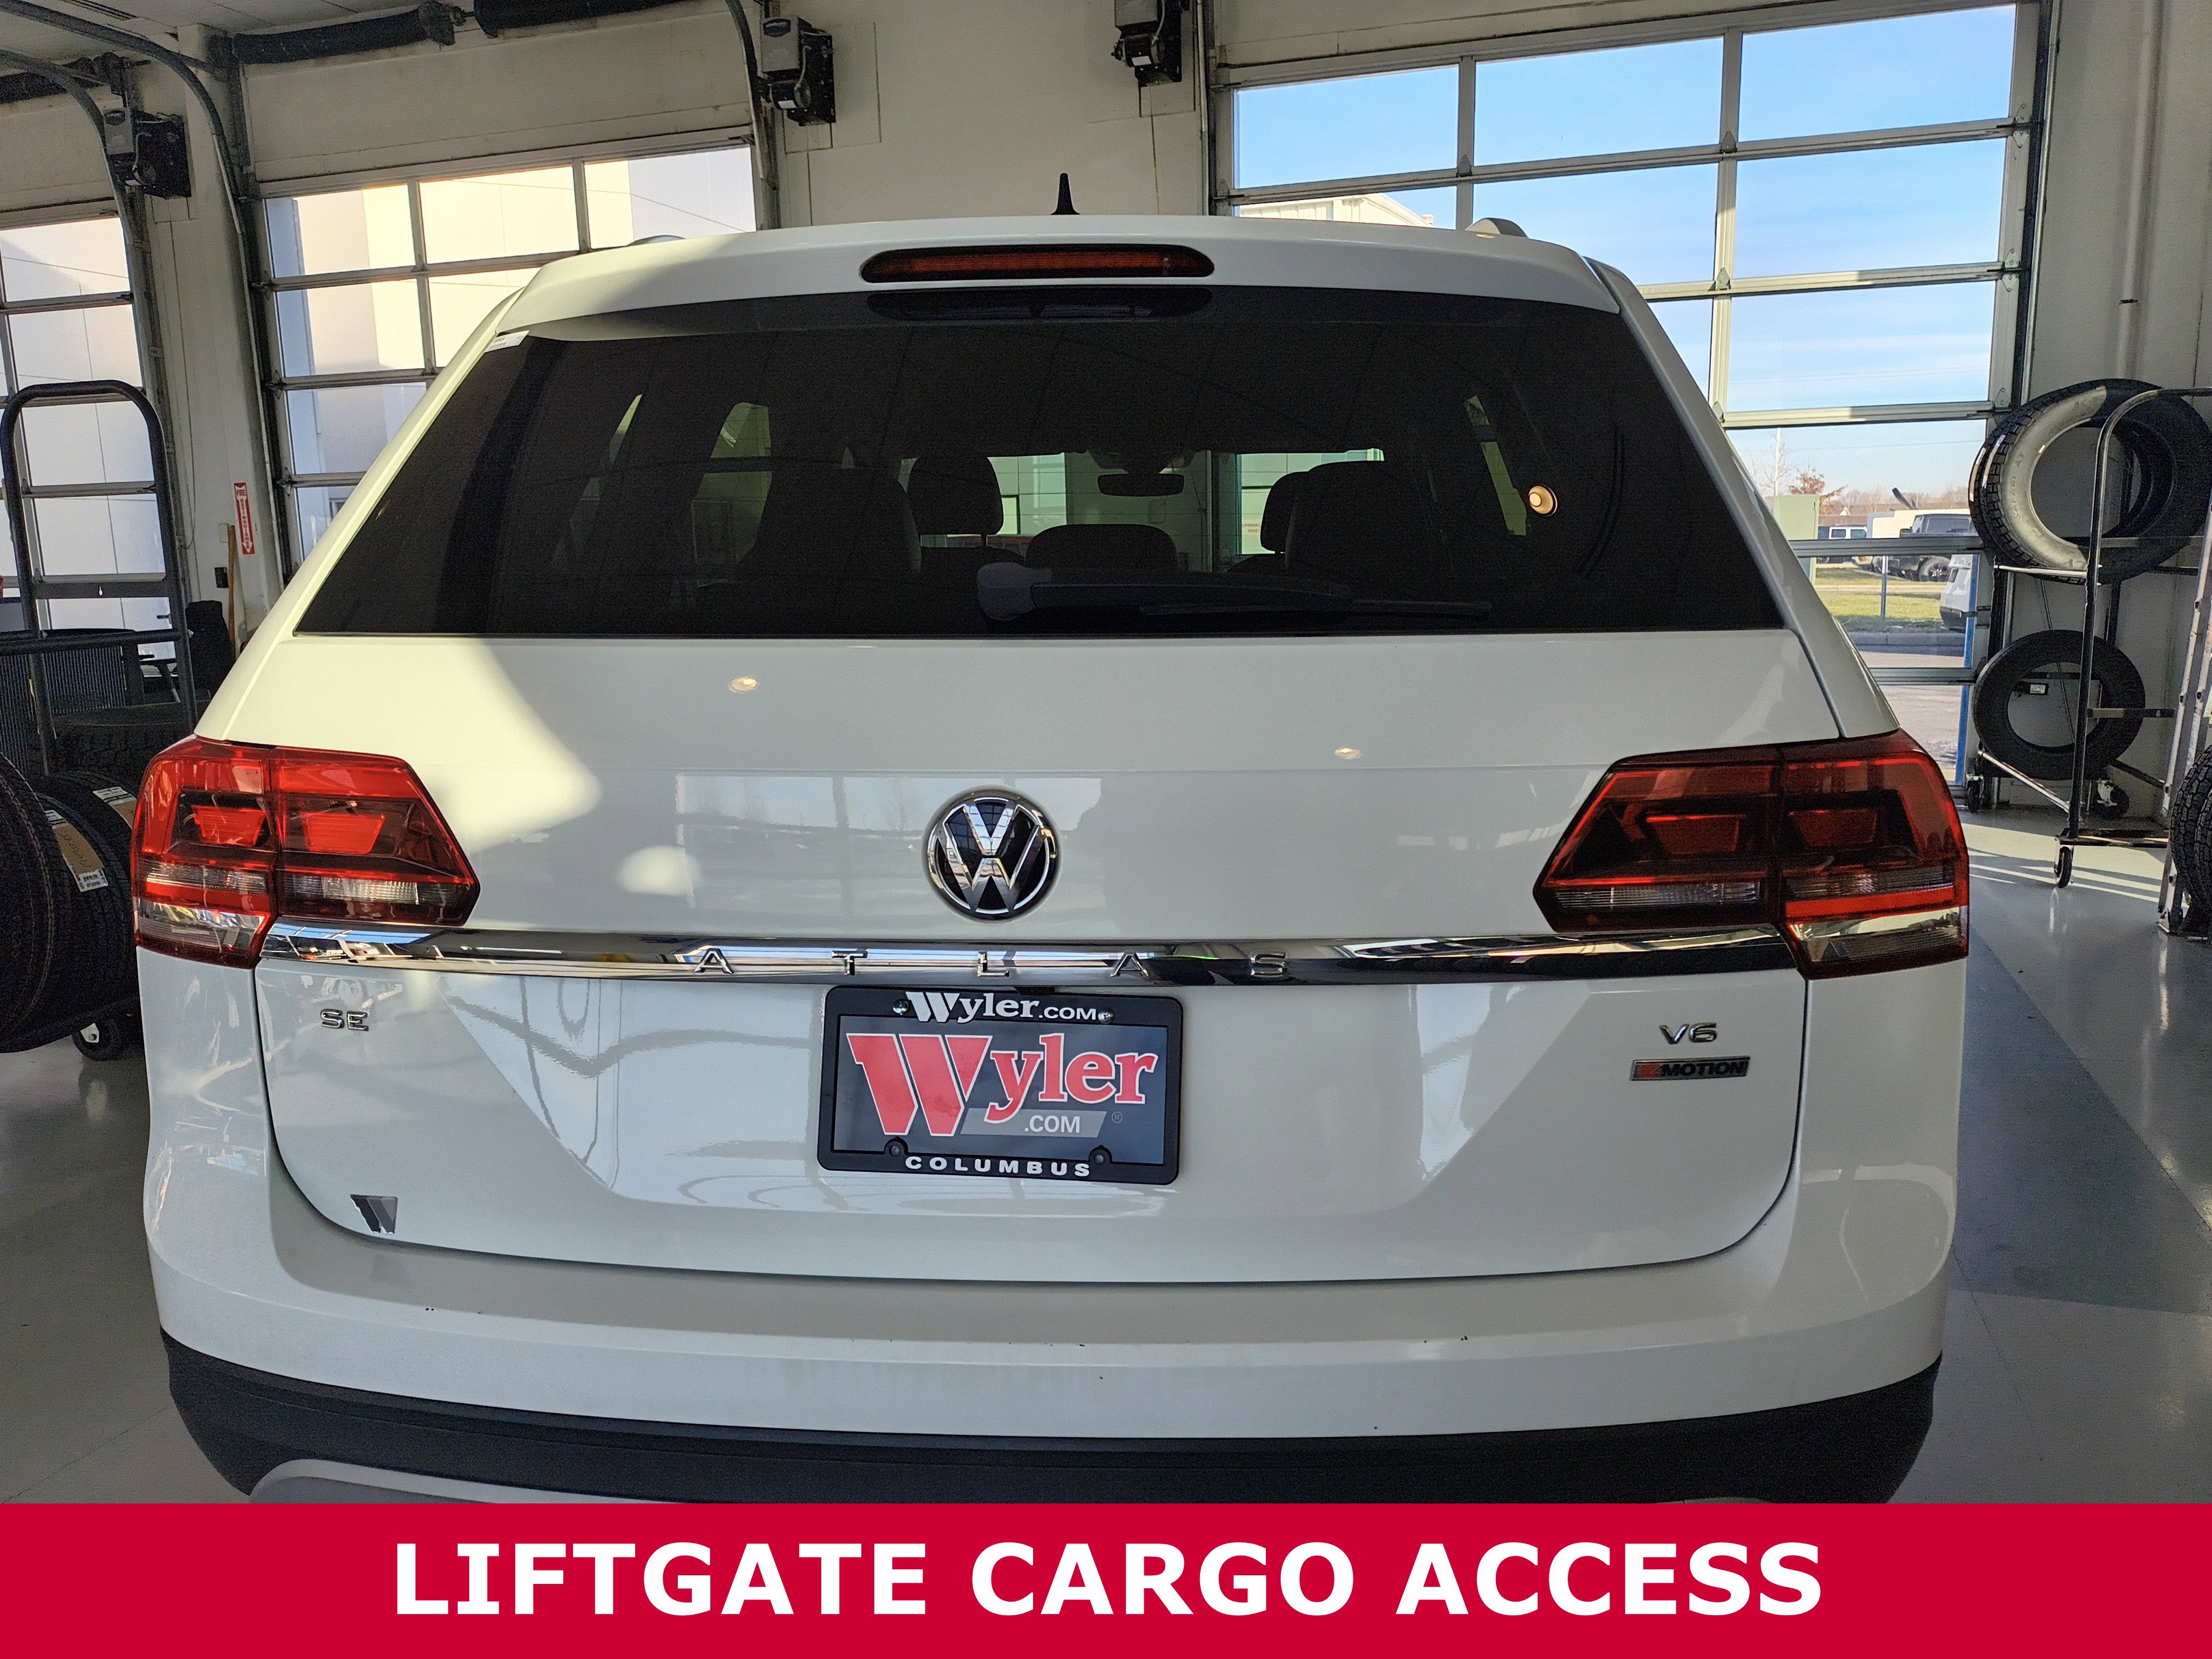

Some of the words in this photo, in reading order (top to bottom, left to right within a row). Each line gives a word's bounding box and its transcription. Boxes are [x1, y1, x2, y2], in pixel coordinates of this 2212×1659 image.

[694, 948, 1289, 976] ATLAS
[320, 1008, 369, 1031] SE
[1658, 1022, 1717, 1044] V6
[846, 1032, 1158, 1136] Wyler
[1024, 1115, 1081, 1134] .COM
[905, 1156, 1090, 1177] COLUMBUS
